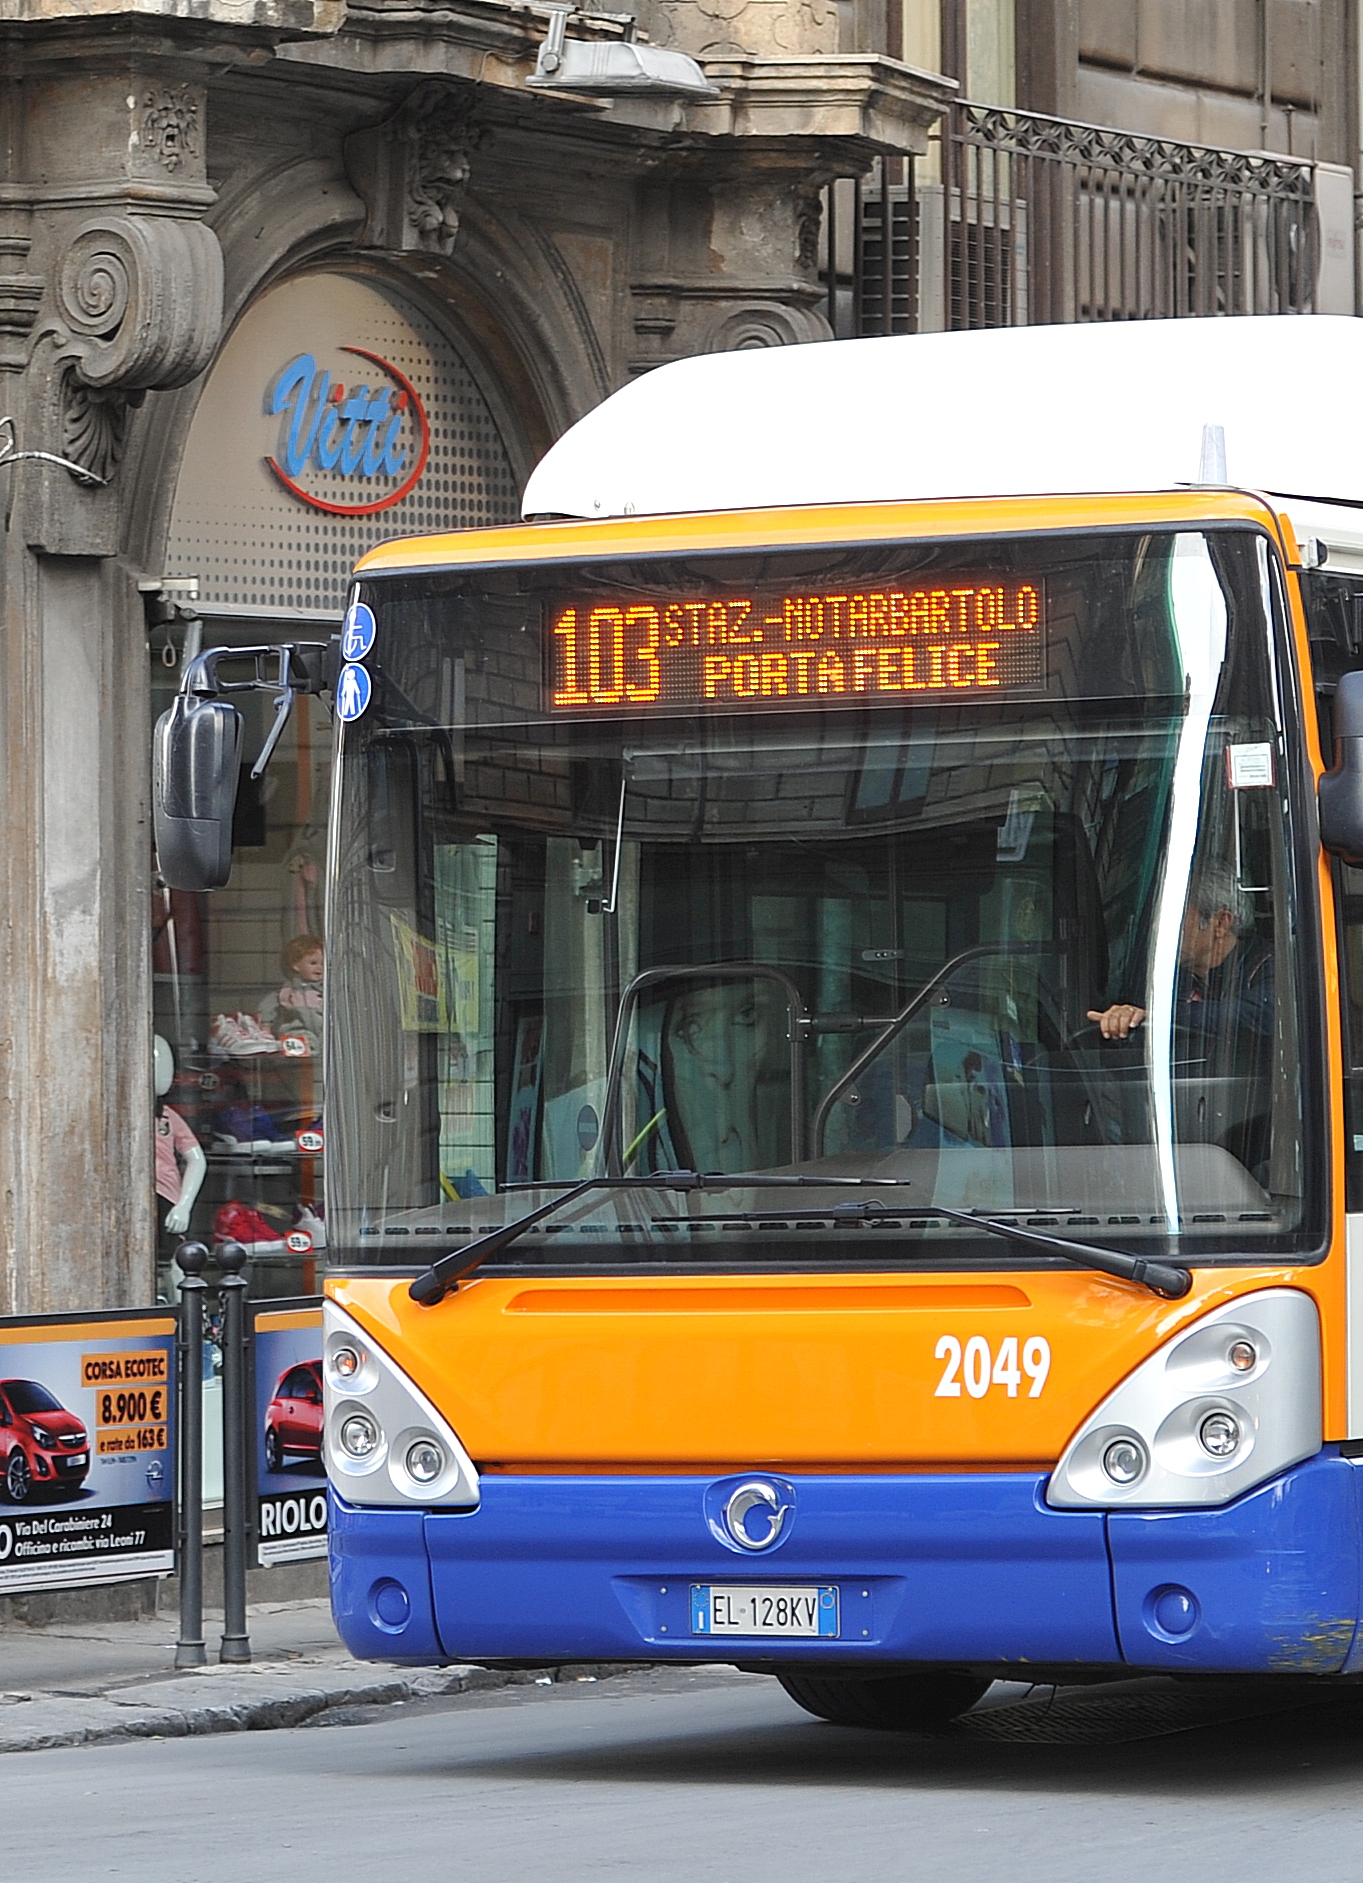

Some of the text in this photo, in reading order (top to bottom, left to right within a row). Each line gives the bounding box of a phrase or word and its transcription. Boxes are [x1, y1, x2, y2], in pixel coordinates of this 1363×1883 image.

[270, 353, 408, 477] Vitti
[552, 605, 661, 705] 103
[704, 641, 1001, 699] PORTA FELICE
[84, 1357, 166, 1381] CORSA ECOTEC
[933, 1334, 1051, 1399] 2049
[101, 1390, 162, 1424] 8.900 €
[137, 1429, 155, 1449] 163
[156, 1427, 165, 1447] €
[15, 1521, 32, 1536] Via
[32, 1519, 48, 1535] Del
[100, 1513, 113, 1529] 24
[261, 1495, 328, 1537] RIOLO
[14, 1540, 52, 1557] Officina
[52, 1542, 59, 1553] e
[95, 1534, 109, 1549] via
[110, 1531, 134, 1548] Leoni
[134, 1530, 146, 1546] 77
